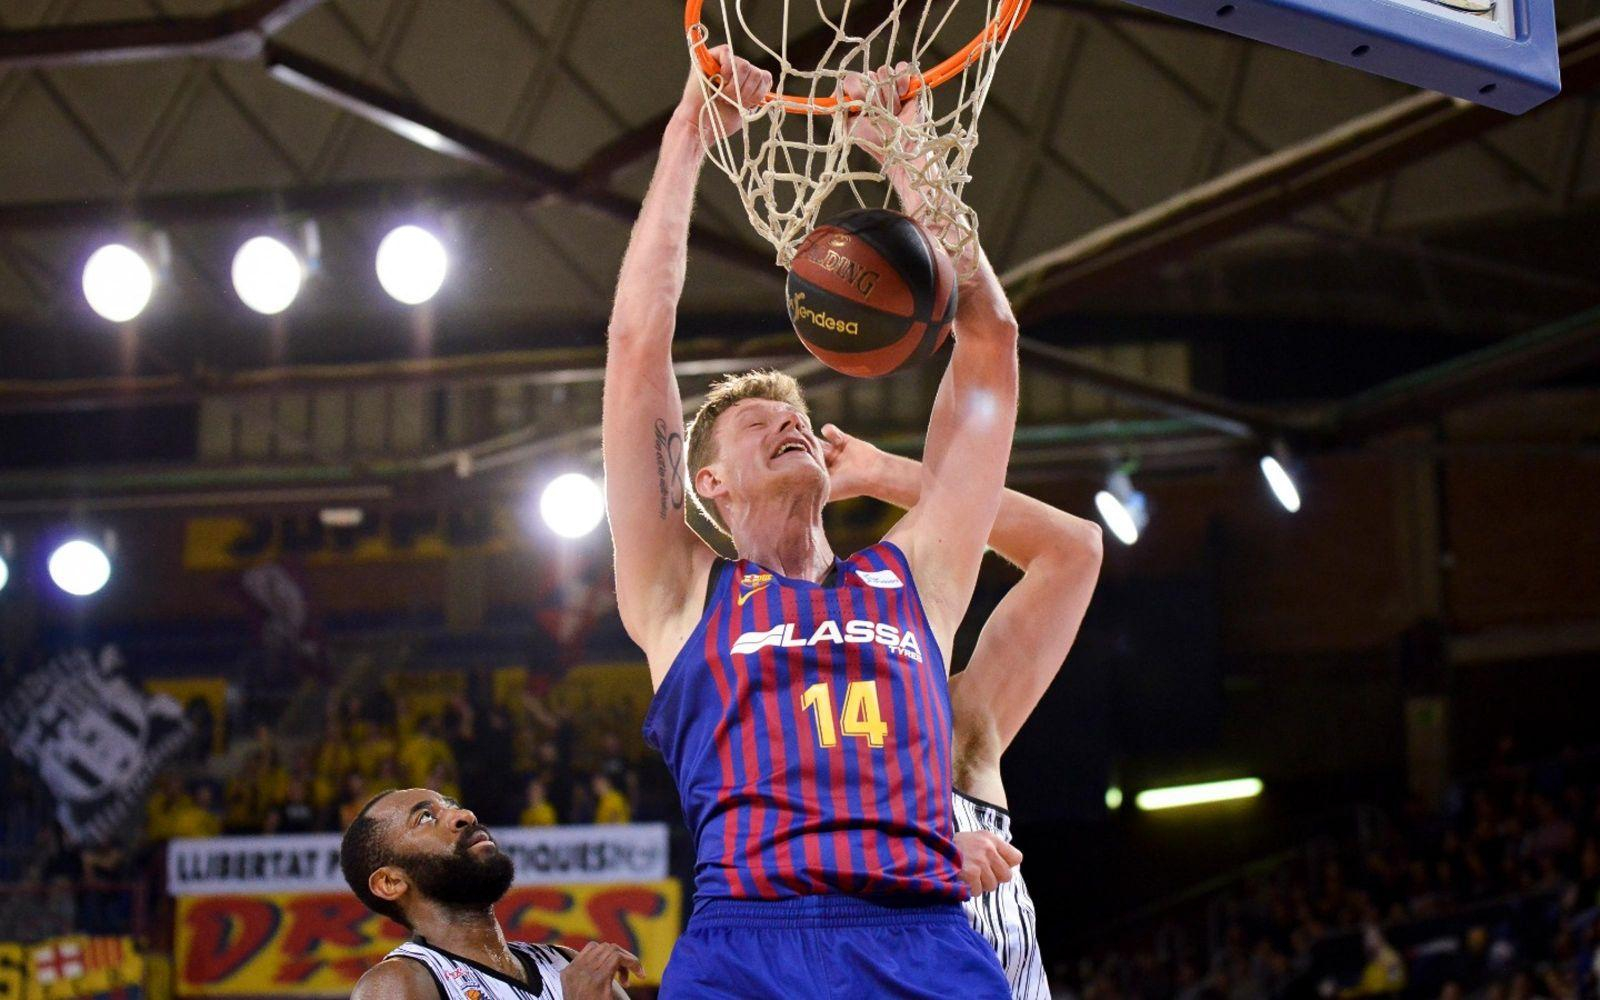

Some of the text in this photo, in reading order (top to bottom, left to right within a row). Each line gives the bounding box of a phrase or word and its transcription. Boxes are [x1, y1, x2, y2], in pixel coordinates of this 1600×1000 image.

[814, 249, 880, 299] DING
[799, 306, 858, 335] endesa
[781, 619, 922, 657] LASSA
[800, 680, 888, 748] 14
